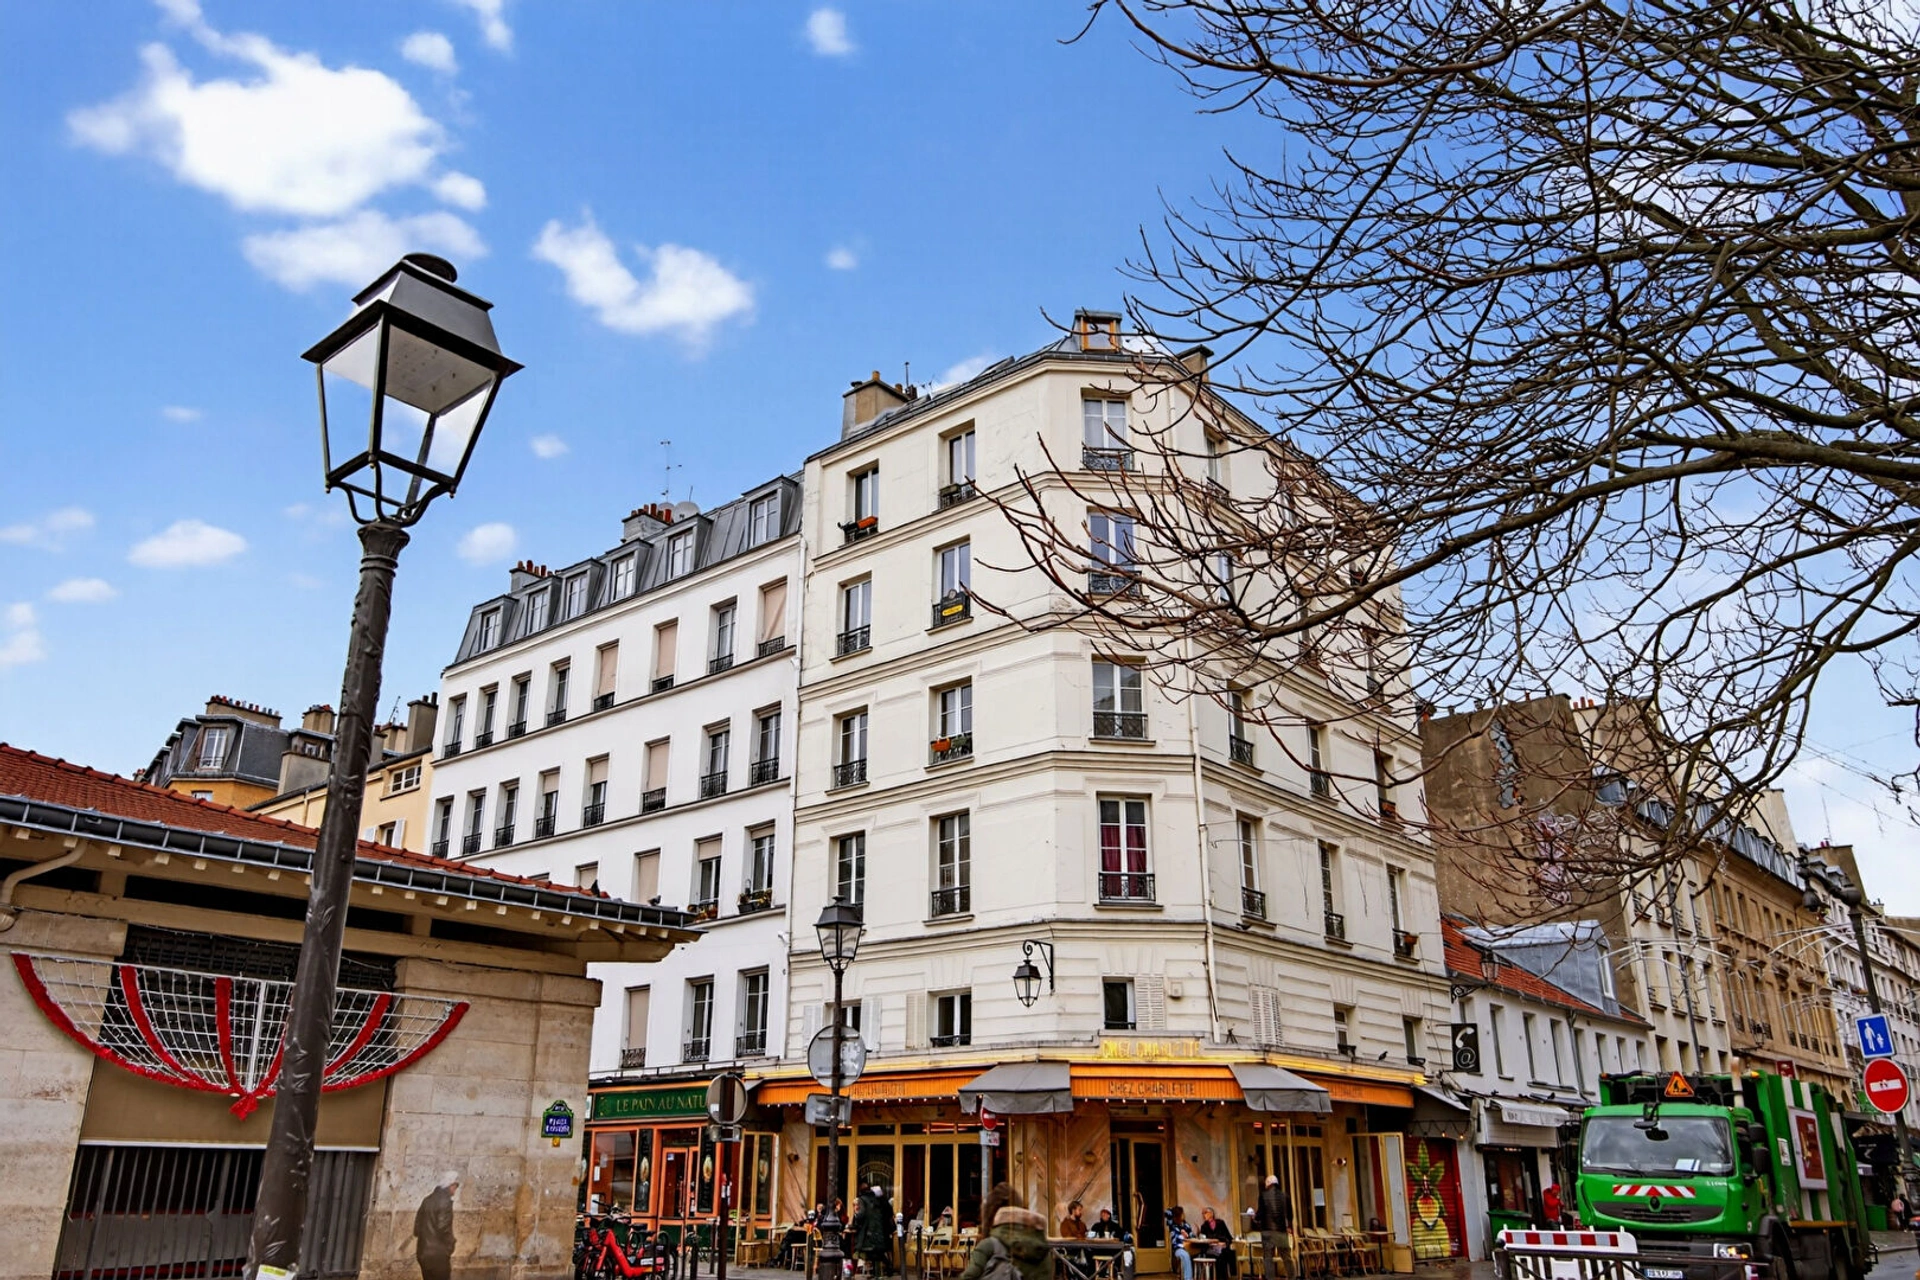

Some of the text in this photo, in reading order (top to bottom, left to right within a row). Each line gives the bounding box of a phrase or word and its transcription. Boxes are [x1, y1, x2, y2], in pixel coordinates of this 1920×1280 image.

[1109, 1080, 1134, 1095] CHEZ
[616, 1099, 629, 1113] LE
[631, 1097, 656, 1112] PAIN
[657, 1096, 674, 1110] AU
